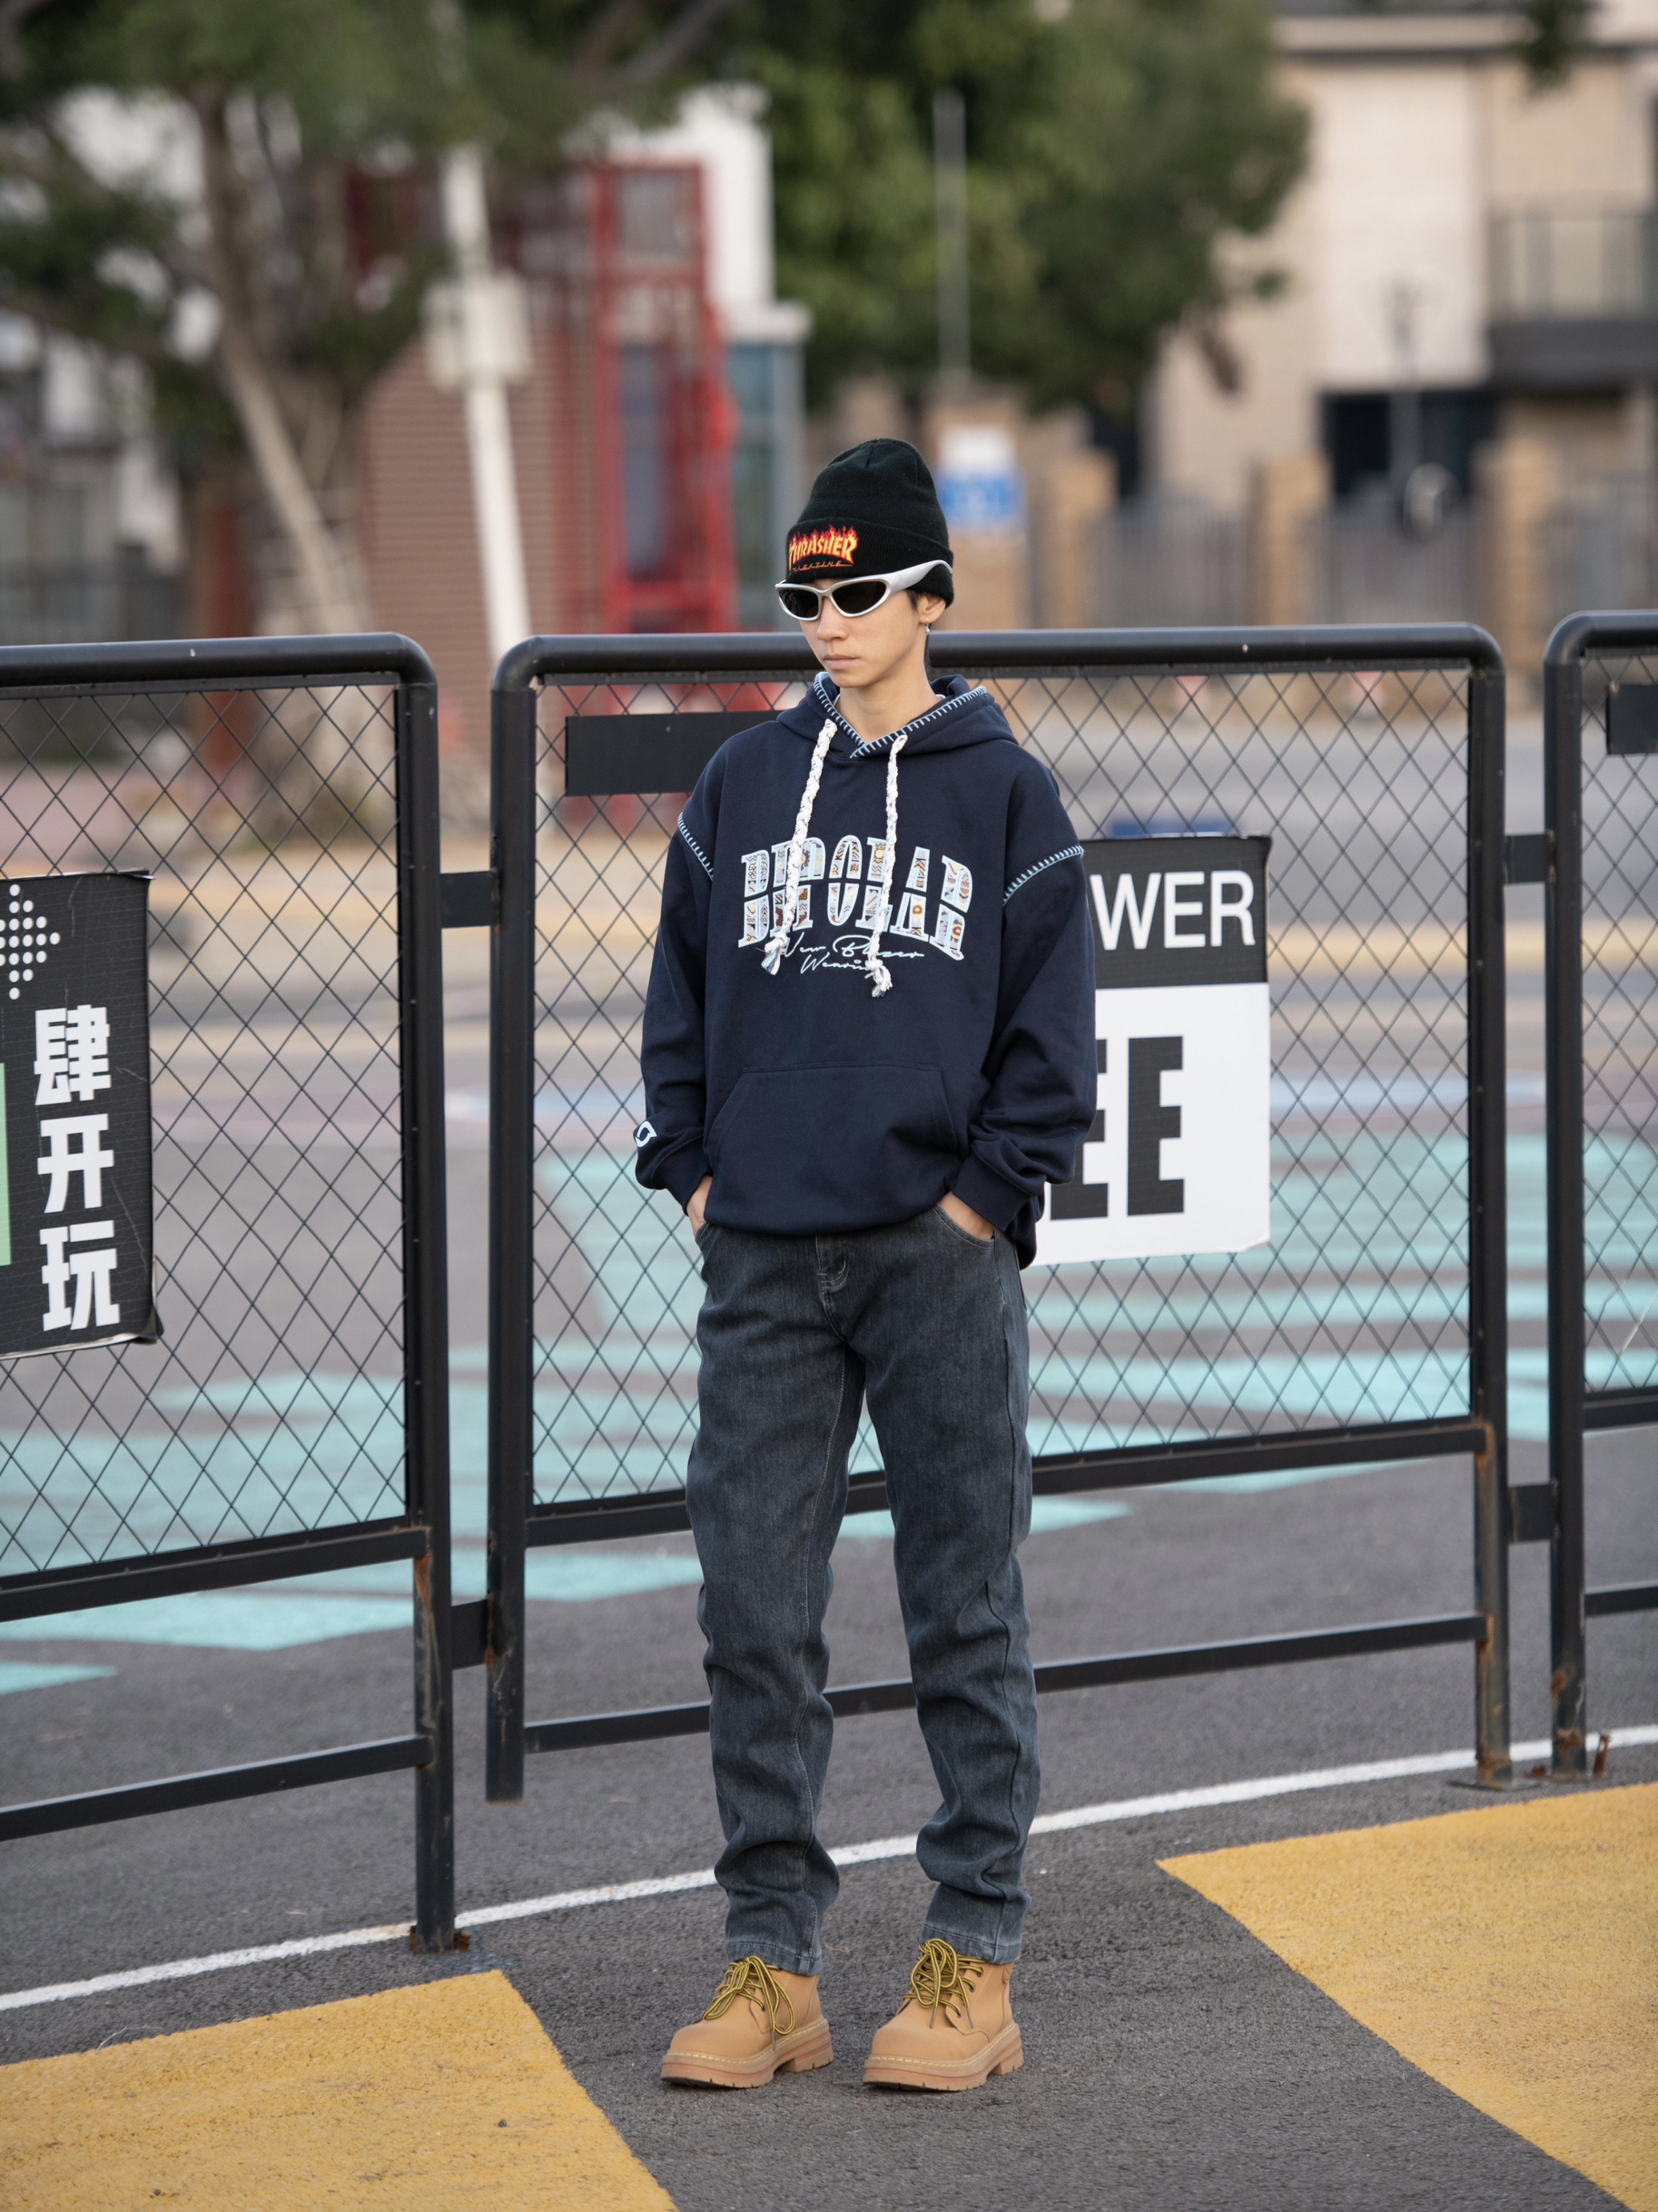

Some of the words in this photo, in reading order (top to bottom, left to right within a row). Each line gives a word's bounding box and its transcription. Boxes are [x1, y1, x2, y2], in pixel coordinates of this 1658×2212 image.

[788, 528, 858, 574] THRASHER
[34, 1004, 121, 1332] 肆开玩
